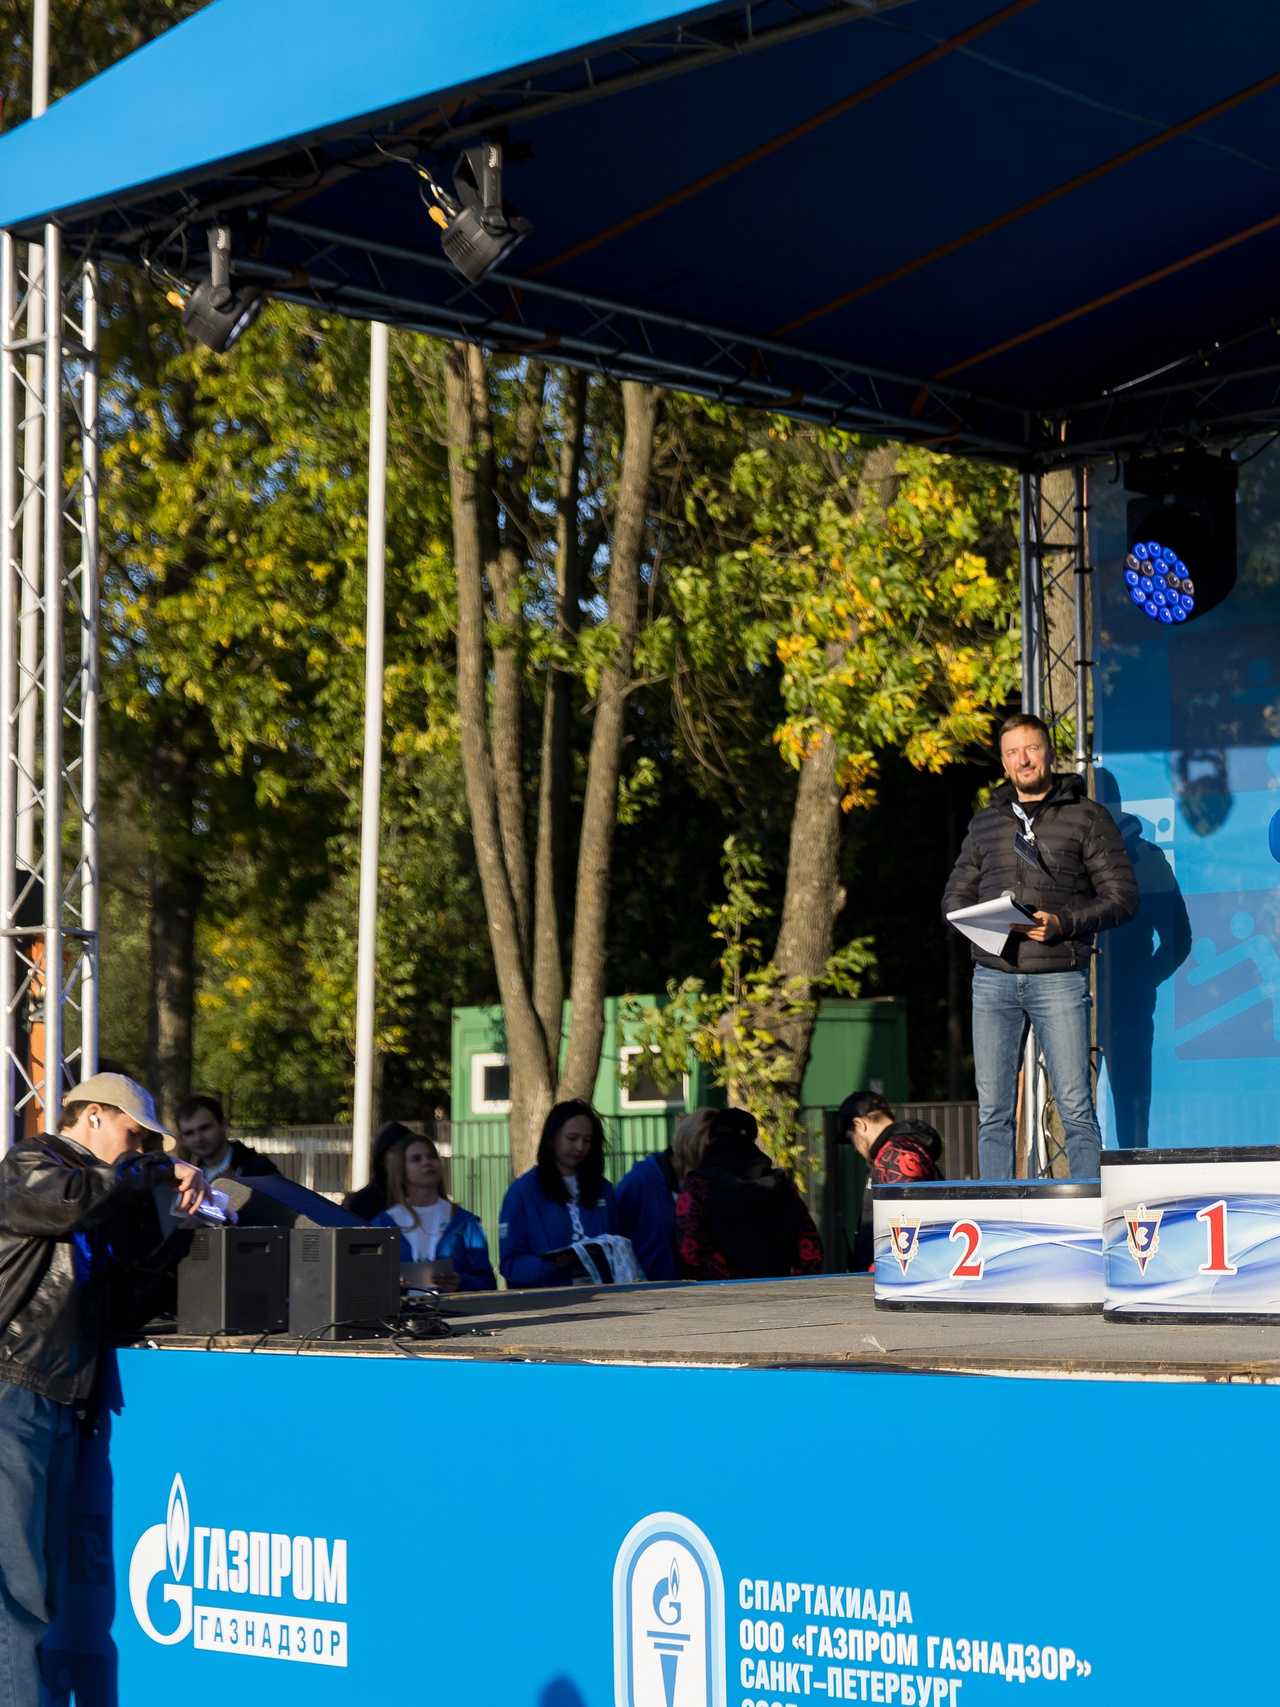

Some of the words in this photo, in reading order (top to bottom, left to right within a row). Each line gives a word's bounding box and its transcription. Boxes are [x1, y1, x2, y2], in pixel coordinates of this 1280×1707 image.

[950, 1221, 984, 1278] 2
[1198, 1201, 1236, 1274] 1
[193, 1526, 348, 1605] ГАЗПРОМ
[738, 1577, 914, 1628] СПАРТАКИАДА
[200, 1615, 341, 1657] ГАЗНАДЗОР
[739, 1618, 785, 1653] ООО
[791, 1624, 919, 1667] «ГАЗПРОМ
[926, 1635, 1092, 1684] ГАЗНАДЗОР»
